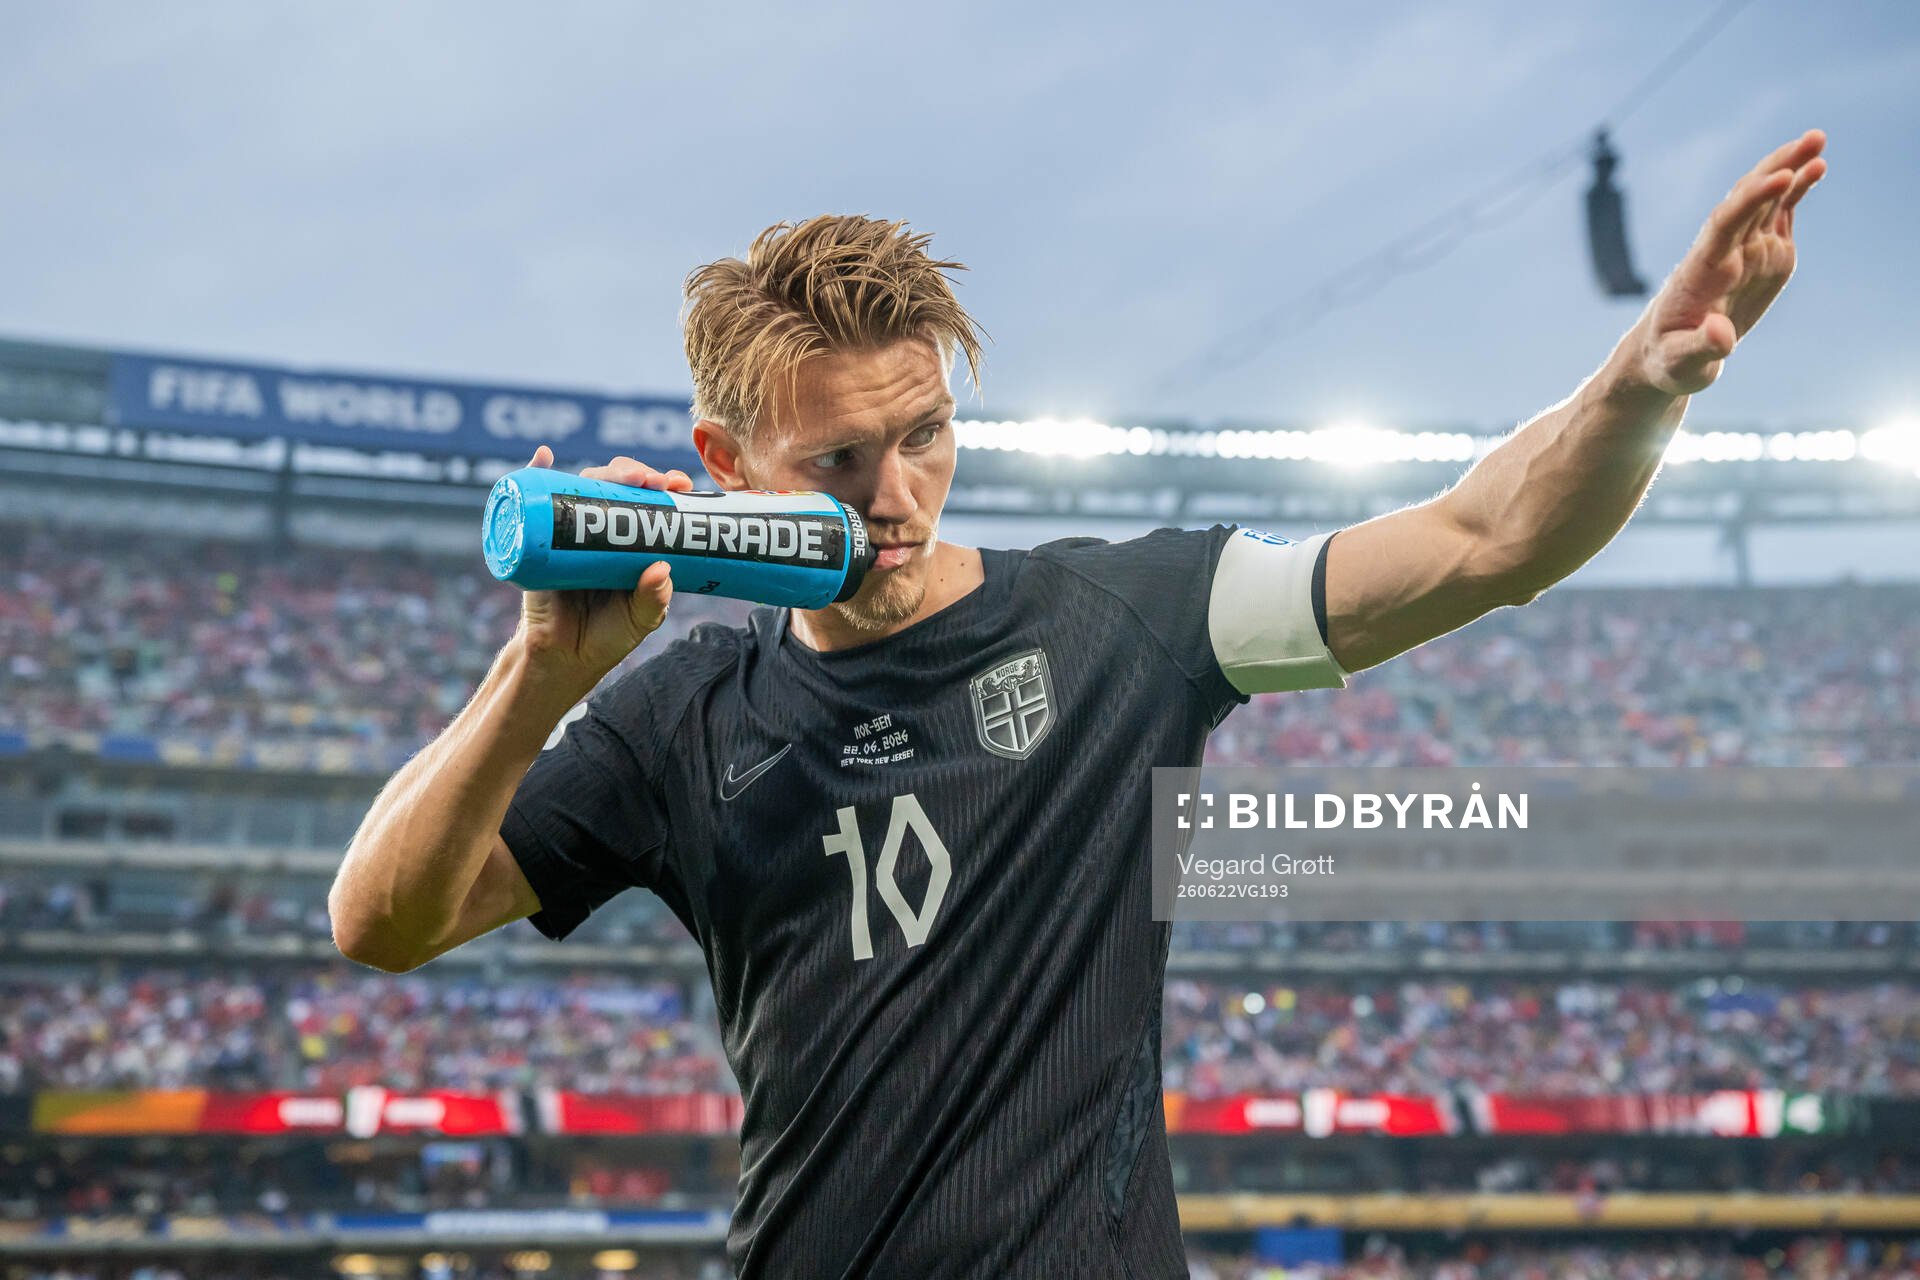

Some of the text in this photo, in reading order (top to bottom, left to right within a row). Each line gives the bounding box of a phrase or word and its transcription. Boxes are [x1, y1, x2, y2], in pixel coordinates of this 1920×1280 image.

[151, 367, 263, 419] FIFA
[278, 378, 463, 434] WORLD
[483, 394, 585, 442] CUP
[575, 503, 824, 561] POWERADE
[995, 662, 1020, 680] NORGE
[853, 713, 892, 740] NOR-SEN
[840, 748, 914, 768] NEW YORK NEW JERSEY
[822, 793, 952, 961] 10
